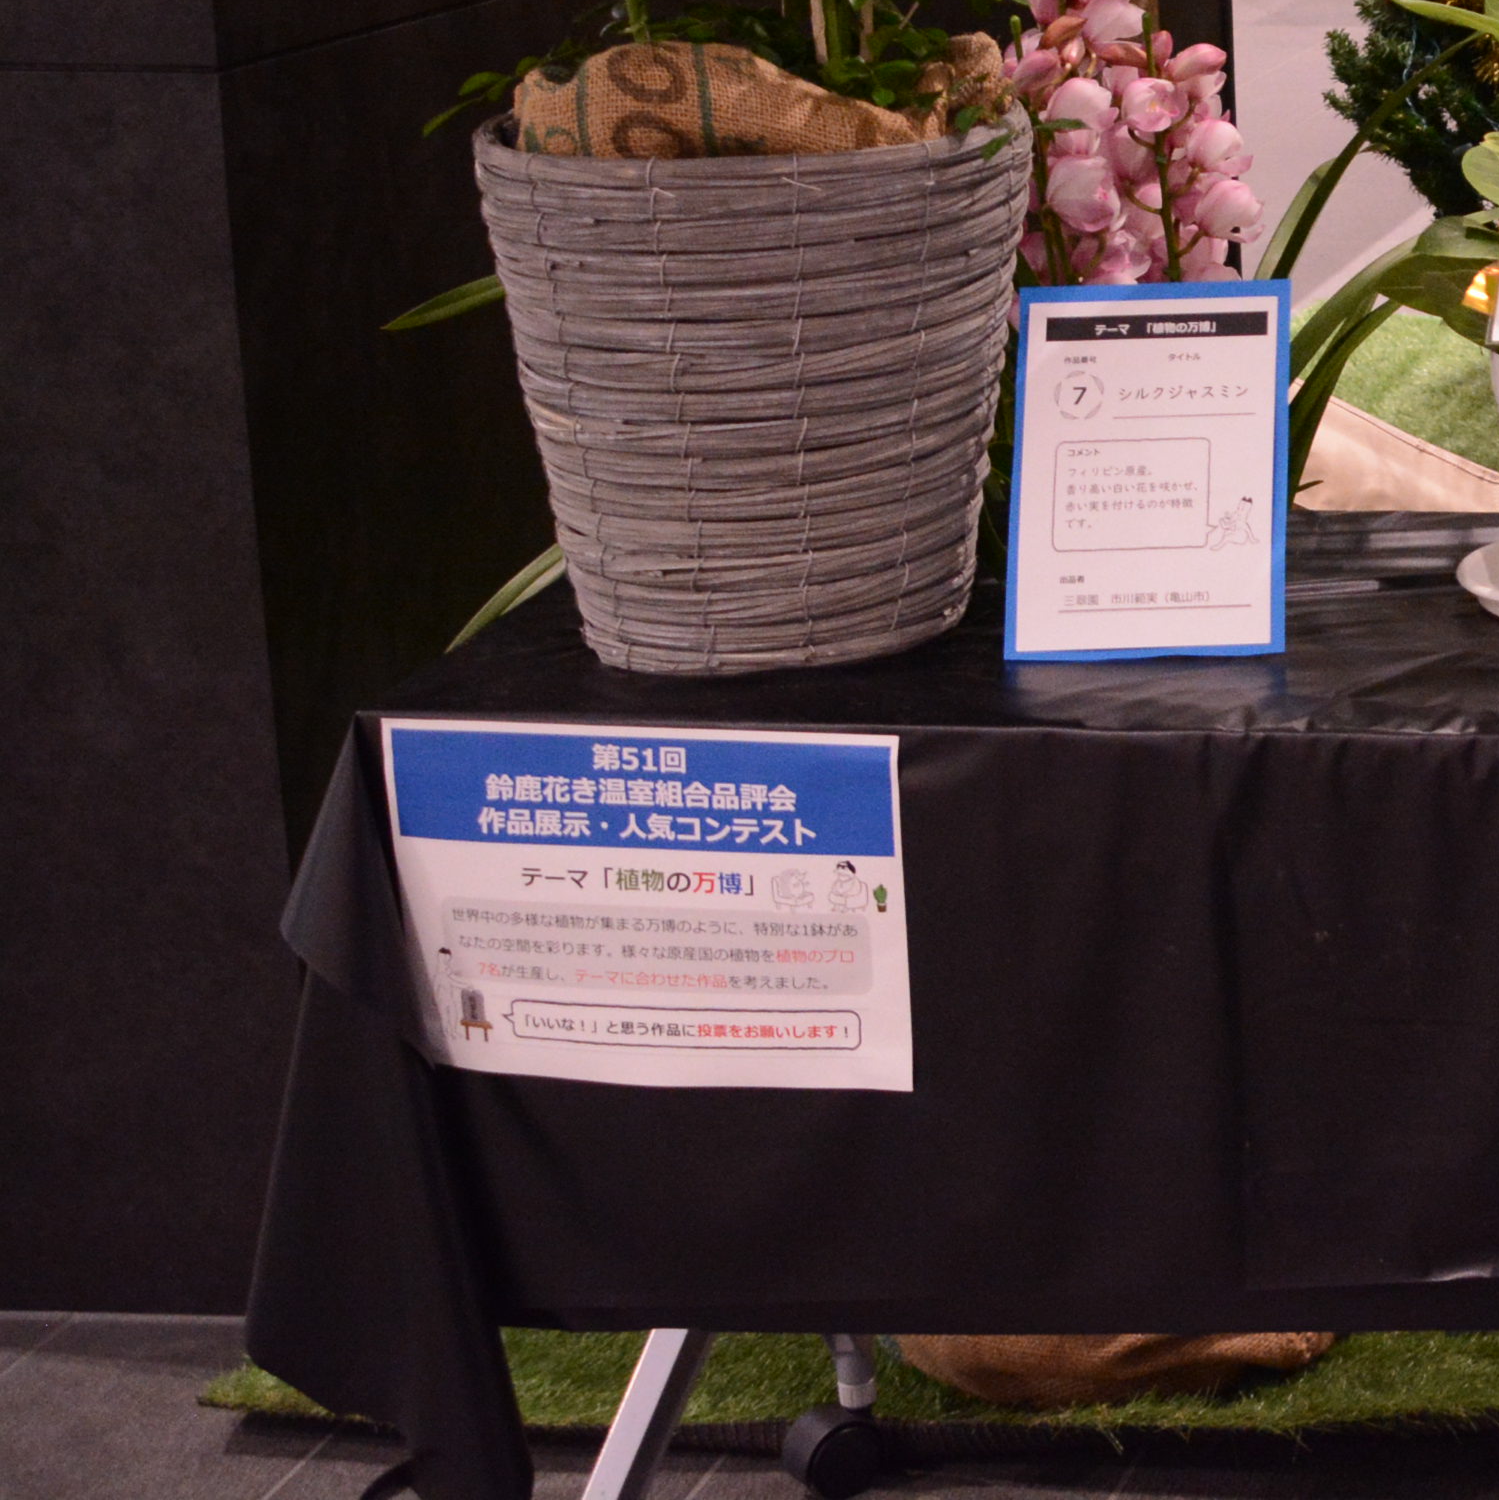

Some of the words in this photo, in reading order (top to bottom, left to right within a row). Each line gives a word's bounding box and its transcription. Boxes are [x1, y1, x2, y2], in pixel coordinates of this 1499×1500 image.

[1095, 323, 1130, 336] テーマ
[1168, 353, 1200, 361] タイトル
[1073, 386, 1087, 405] 7
[1118, 385, 1249, 401] シルクジャスミン
[1067, 449, 1100, 457] コメント
[592, 743, 686, 774] 第51回
[486, 774, 797, 812] 鈴鹿花き温室組合品評会
[478, 808, 816, 846] 作品展示・人気コンテスト
[522, 867, 755, 896] テーマ「植物の万博」
[525, 1015, 850, 1040] 「いいな！」と思う作品に投票をお願いします！
